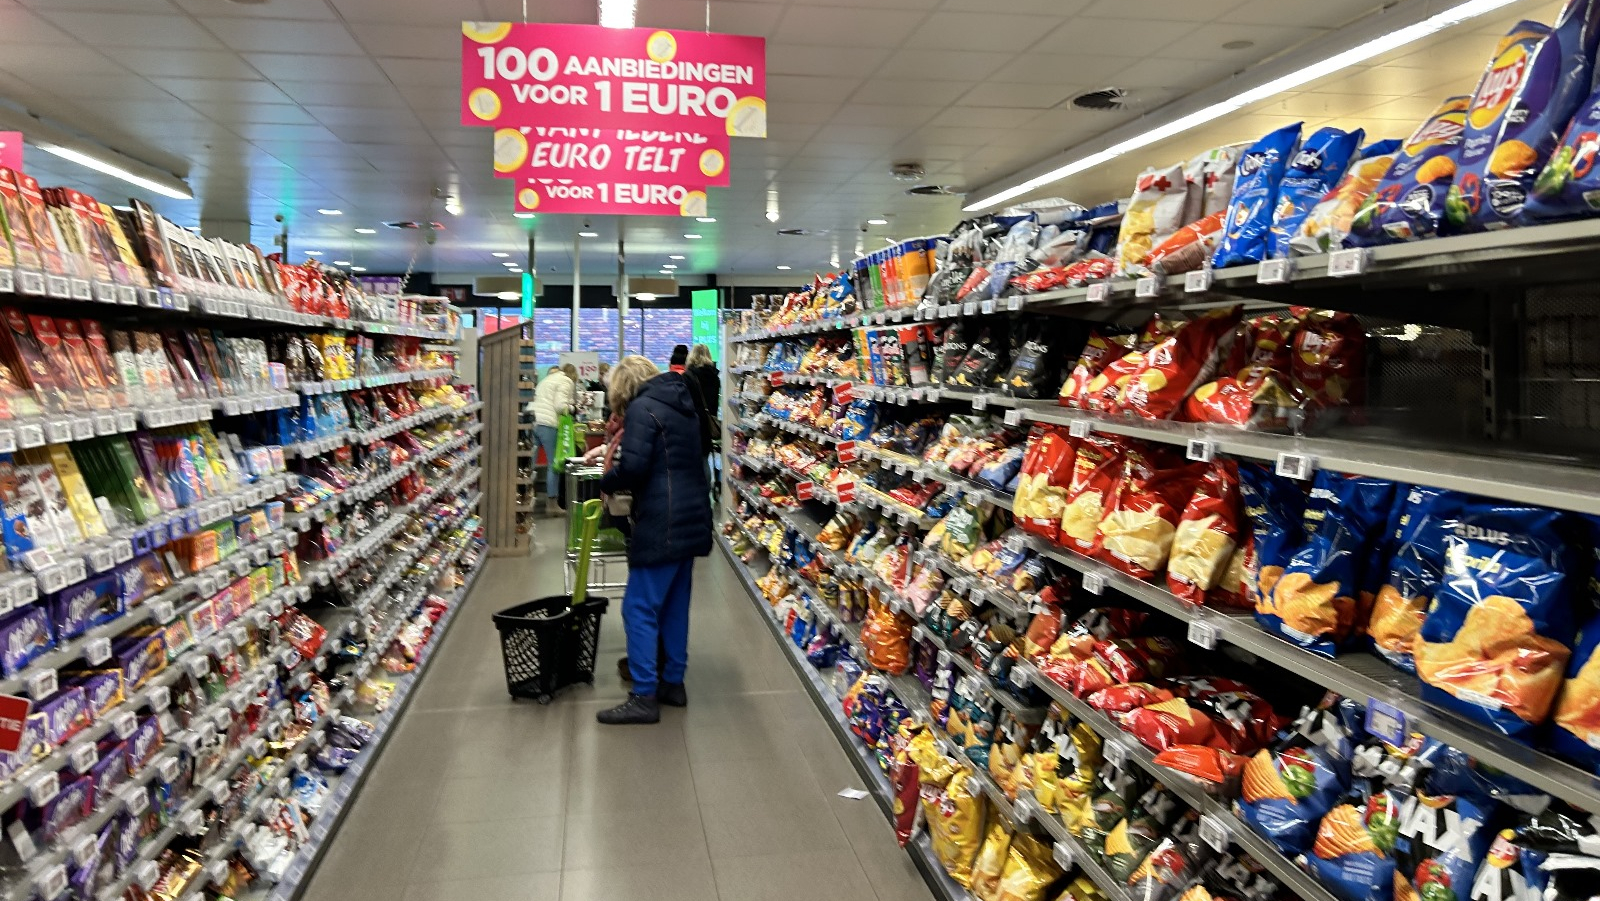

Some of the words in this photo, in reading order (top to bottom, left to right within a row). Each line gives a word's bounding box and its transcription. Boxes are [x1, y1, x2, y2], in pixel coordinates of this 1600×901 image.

[477, 46, 559, 82] 100
[563, 55, 753, 85] AANBIEDINGEN
[511, 83, 588, 106] VOOR
[595, 81, 611, 112] 1
[622, 82, 738, 119] EURO
[531, 141, 612, 170] EURO
[624, 145, 686, 173] TELT
[544, 185, 594, 199] VOOR
[597, 183, 608, 203] 1
[614, 183, 688, 205] EURO
[1466, 525, 1510, 546] PLUS
